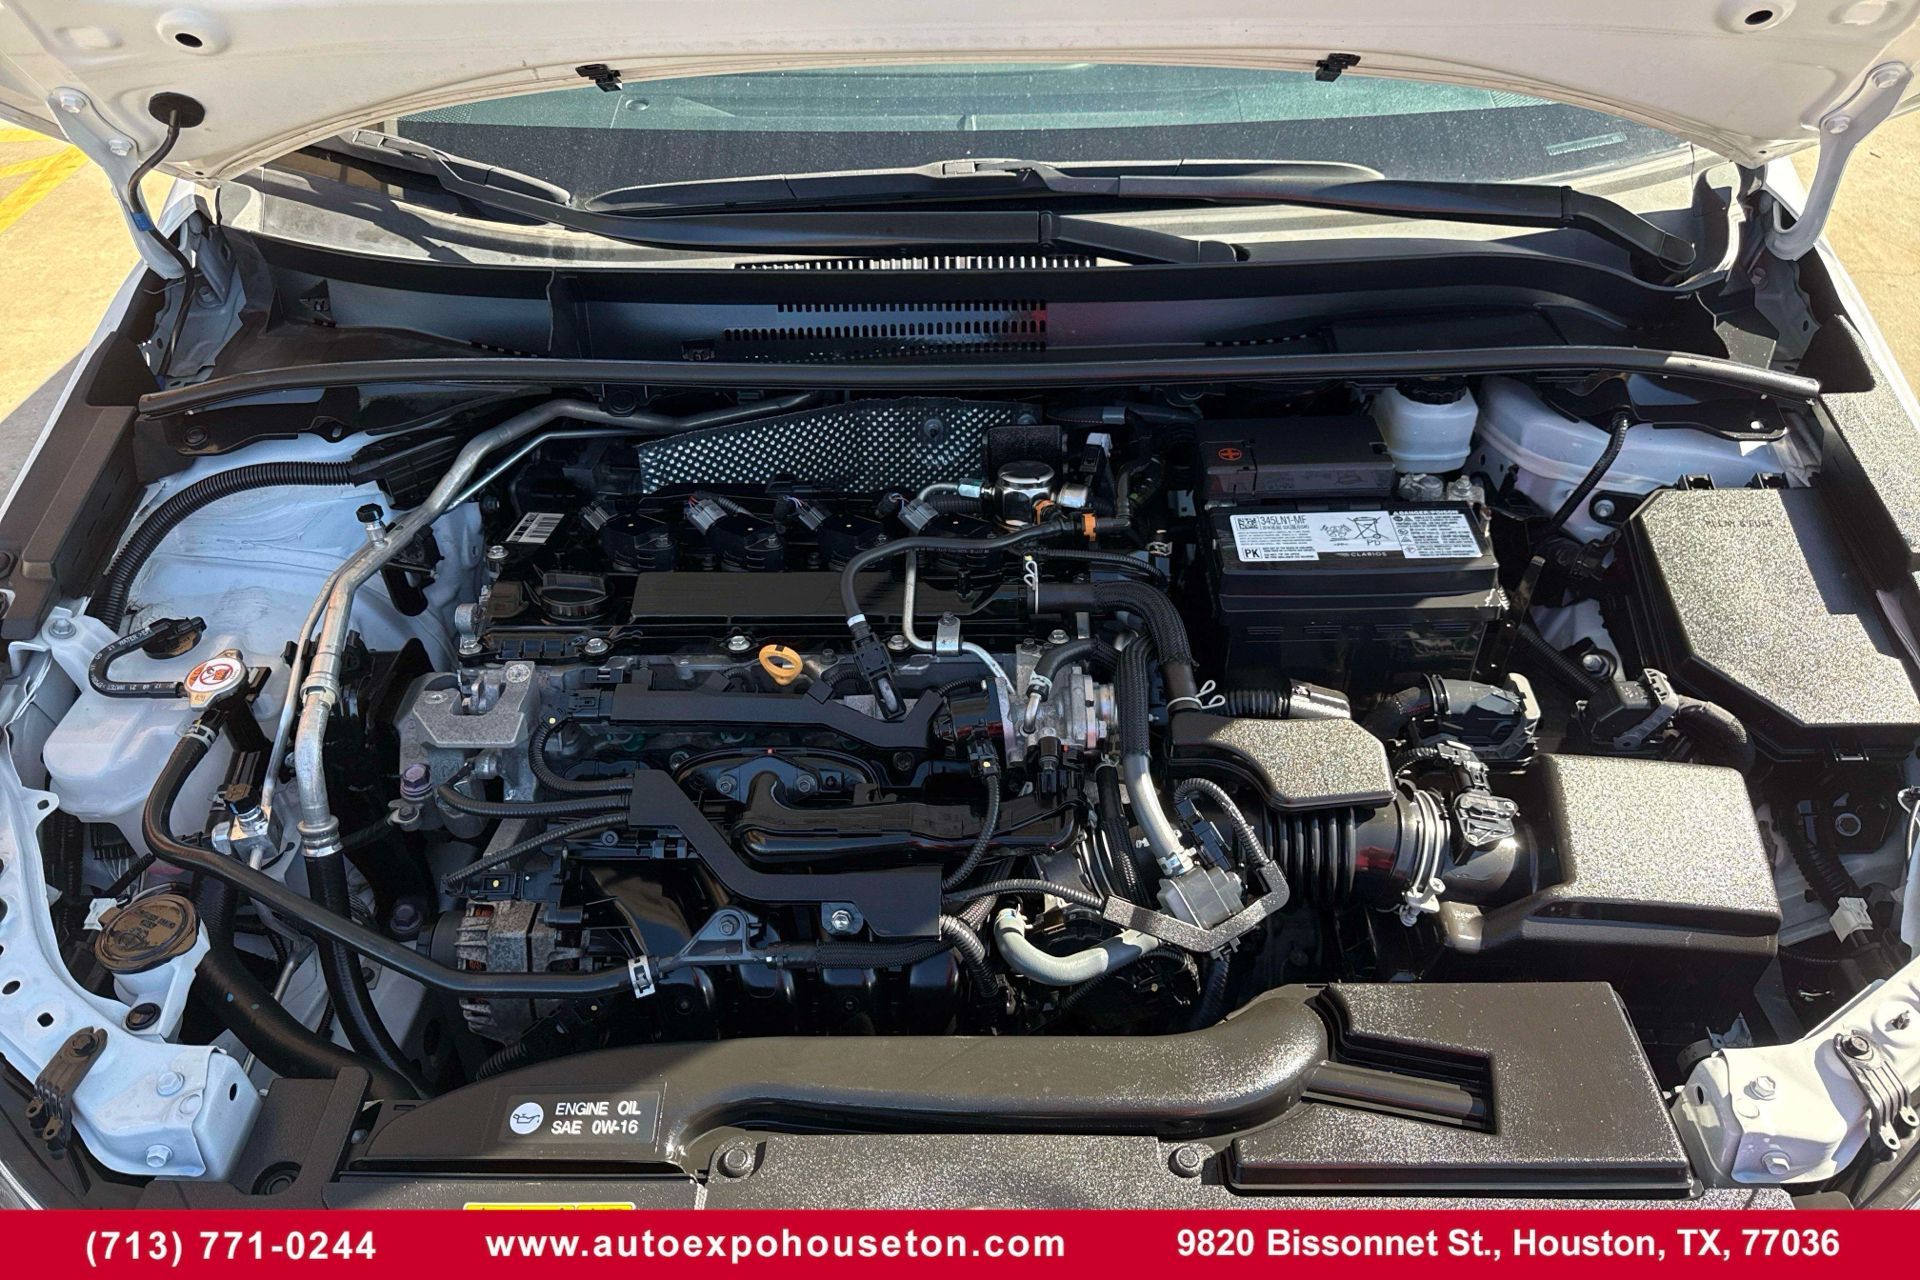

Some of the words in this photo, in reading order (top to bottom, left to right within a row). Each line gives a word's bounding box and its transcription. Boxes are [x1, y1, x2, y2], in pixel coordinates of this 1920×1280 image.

[1260, 515, 1307, 526] 345LN1-MF
[1244, 548, 1260, 558] PK
[555, 1101, 609, 1116] ENGINE
[617, 1100, 641, 1115] OIL
[551, 1120, 583, 1134] SAE
[592, 1119, 639, 1134] 0W-16
